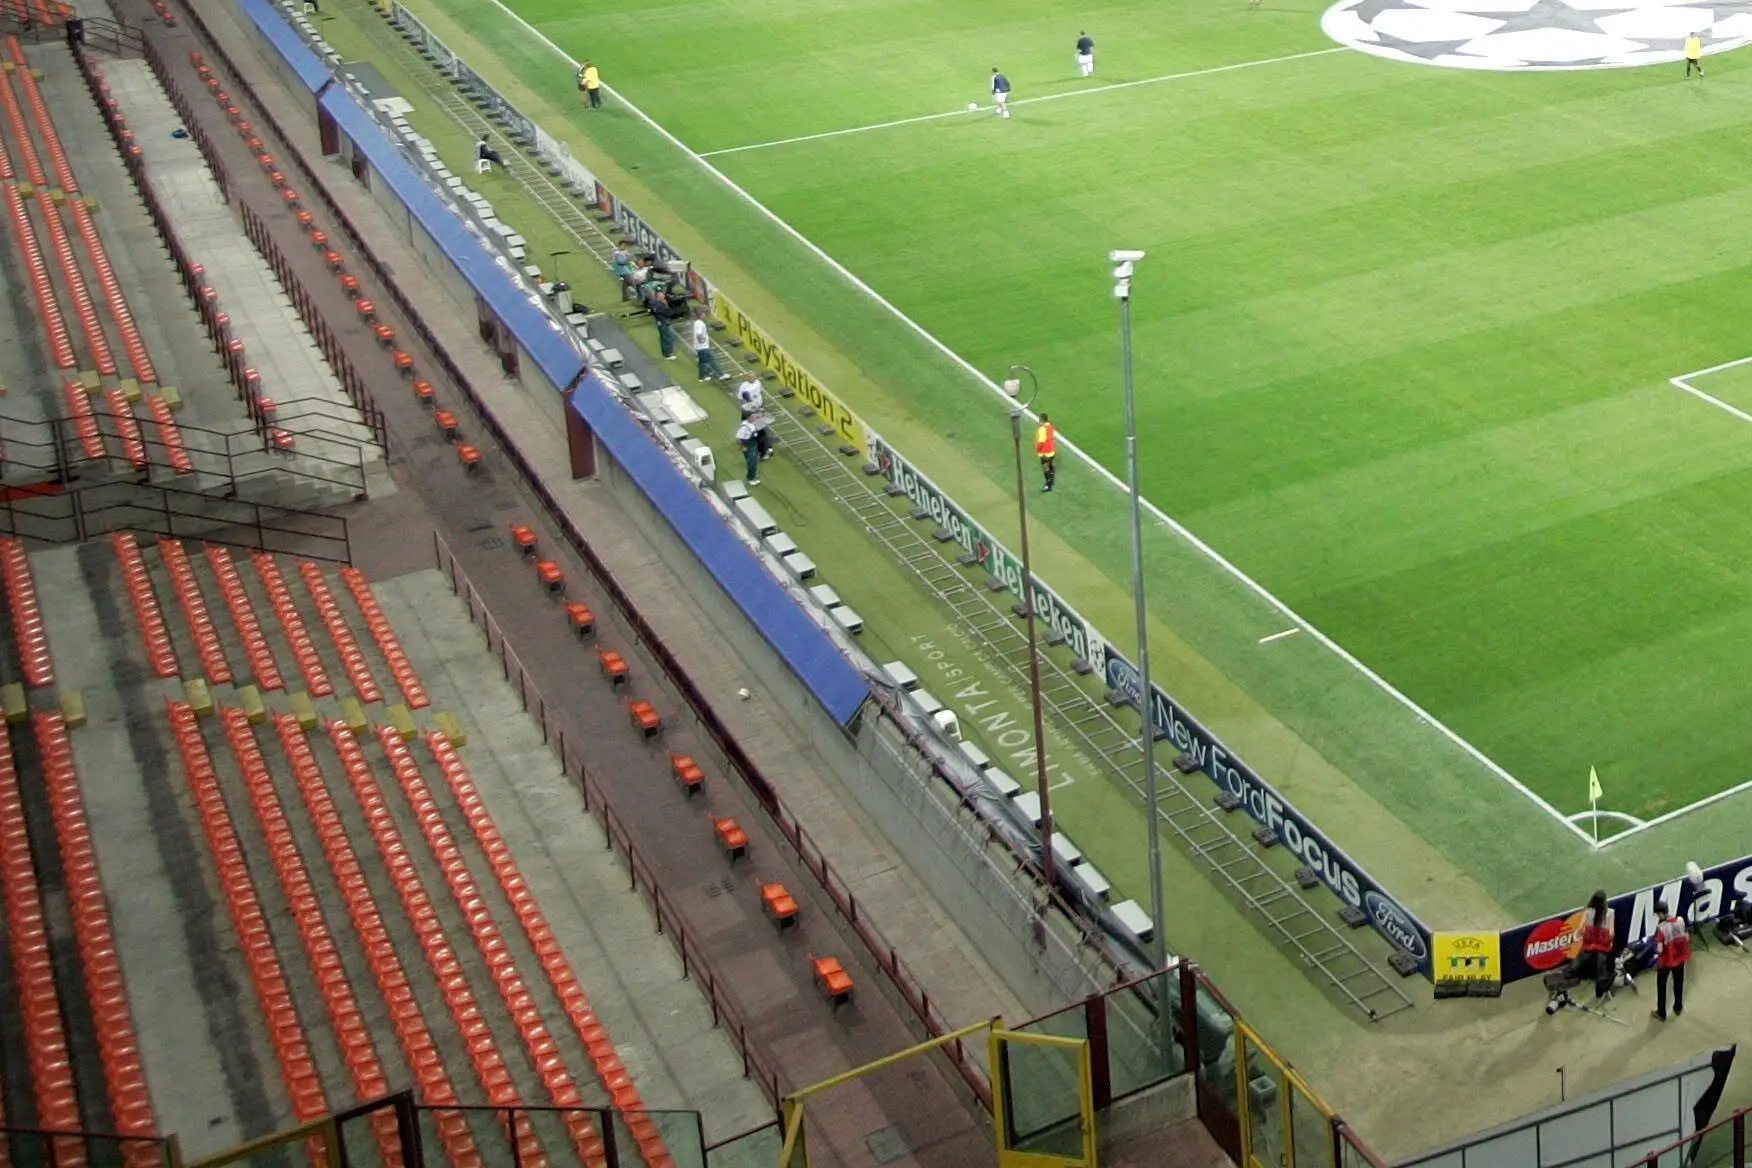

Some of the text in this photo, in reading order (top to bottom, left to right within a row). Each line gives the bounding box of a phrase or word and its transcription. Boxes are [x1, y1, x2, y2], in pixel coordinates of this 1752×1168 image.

[738, 312, 834, 421] PlayStation
[892, 455, 973, 551] Heineken
[1157, 694, 1360, 907] New FordFocus
[1375, 901, 1416, 951] Ford
[1526, 932, 1584, 958] MasterC
